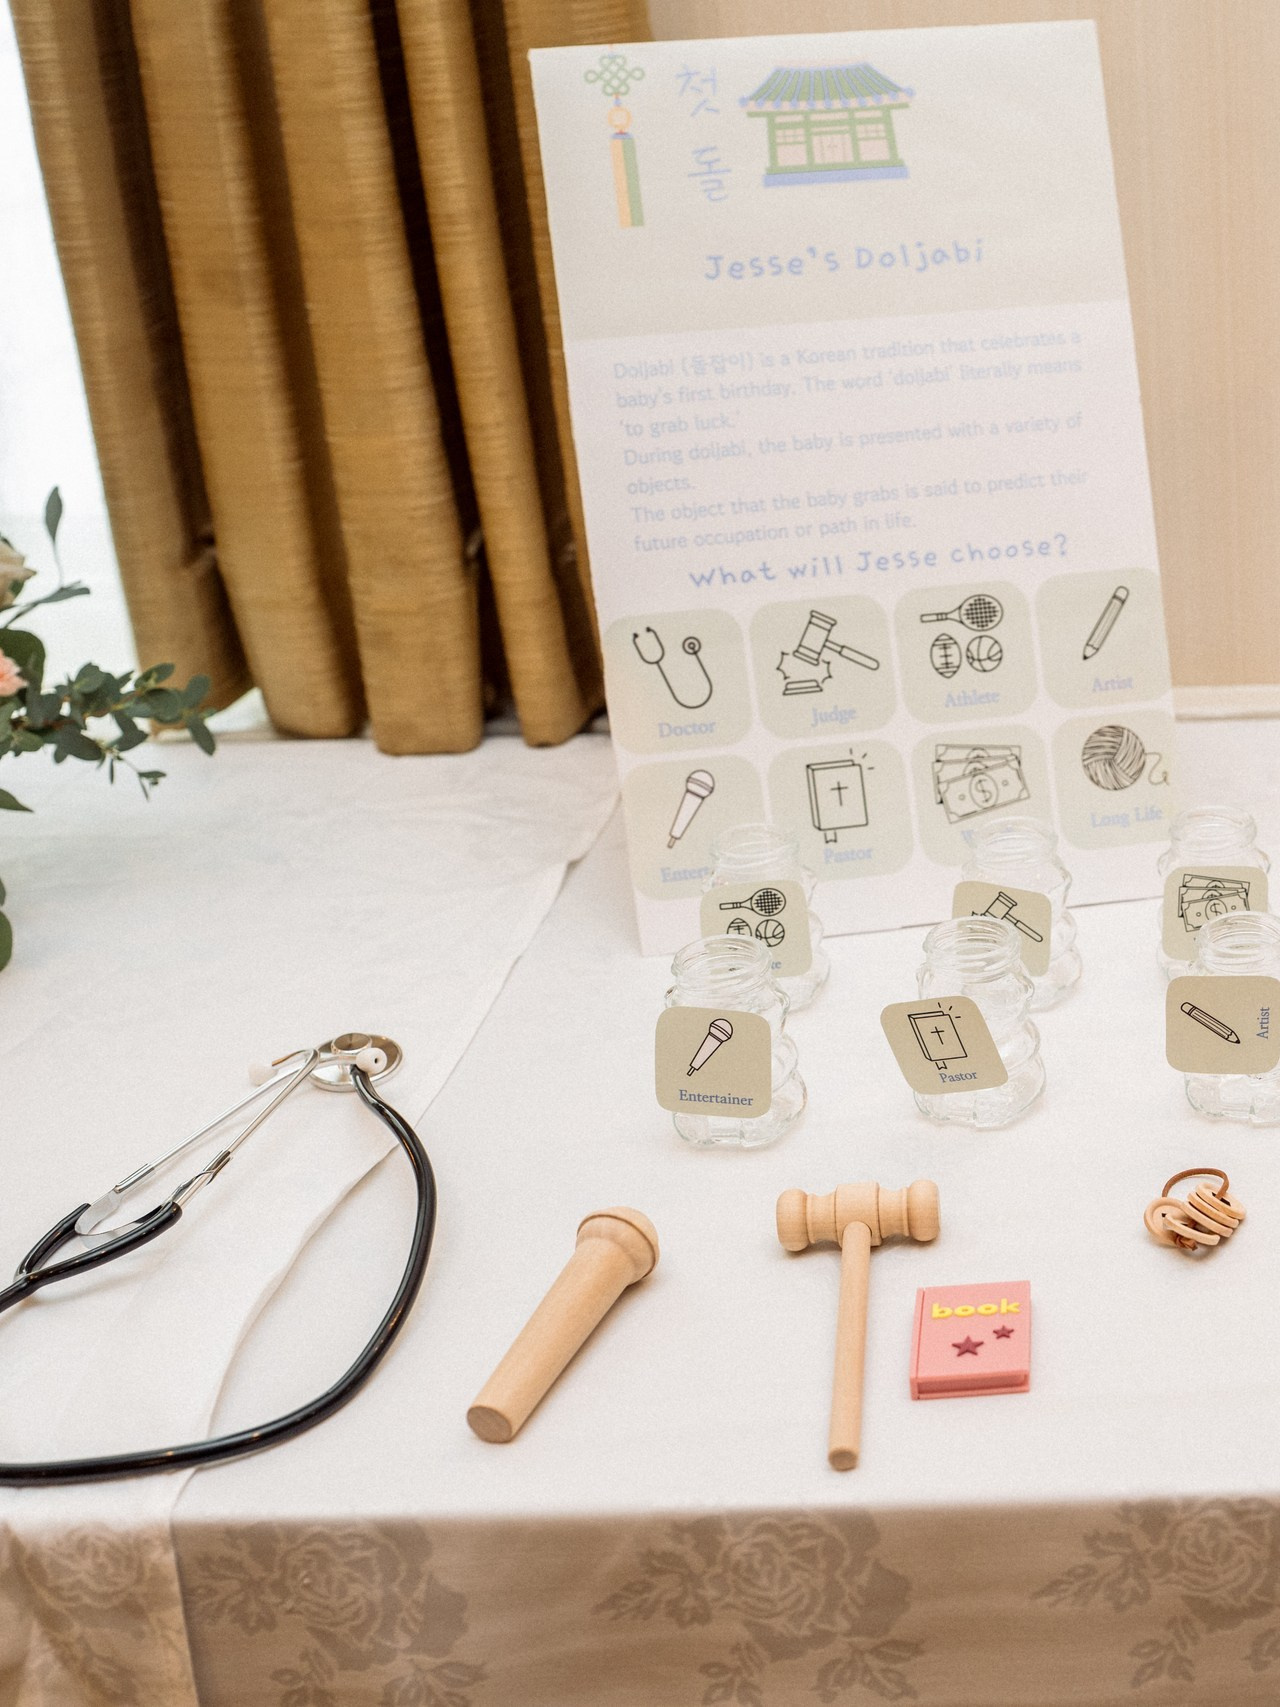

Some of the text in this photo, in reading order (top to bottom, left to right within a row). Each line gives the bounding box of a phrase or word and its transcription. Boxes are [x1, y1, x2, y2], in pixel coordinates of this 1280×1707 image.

[675, 64, 732, 202] 첫 돌
[705, 239, 984, 281] Jesse's Doljabi
[614, 360, 673, 380] Doljabi
[761, 353, 775, 367] is
[781, 355, 790, 366] a
[797, 348, 857, 364] Korean
[862, 340, 934, 359] tradition
[940, 337, 973, 353] that
[980, 332, 1066, 350] celebrates
[1071, 332, 1081, 343] a
[616, 387, 673, 409] baby's
[678, 384, 712, 403] first
[720, 380, 797, 399] birthday.
[803, 375, 836, 392] The
[842, 372, 883, 389] word
[960, 361, 1021, 380] literally
[1027, 359, 1082, 374] means
[624, 447, 685, 466] During
[759, 438, 786, 454] the
[792, 432, 833, 451] baby
[840, 432, 853, 446] is
[859, 426, 942, 448] presented
[949, 421, 984, 438] with
[990, 423, 999, 435] a
[1005, 416, 1061, 434] variety
[1066, 411, 1082, 428] of
[650, 416, 688, 438] grab
[627, 477, 695, 496] objects.
[631, 469, 1089, 523] The object that the baby grabs is said to predict their
[634, 511, 917, 552] future occupation or path in life.
[689, 533, 1068, 588] What will Jesse choose?
[1092, 675, 1133, 693] Artist
[945, 689, 1001, 708] Athlete
[811, 705, 857, 728] Judge
[658, 720, 716, 738] Doctor
[1090, 806, 1163, 829] Long Life
[824, 847, 873, 864] Pastor
[1256, 1006, 1271, 1040] Artist
[939, 1068, 978, 1084] Pastor
[678, 1088, 754, 1106] Entertainer
[931, 1298, 1021, 1319] book
